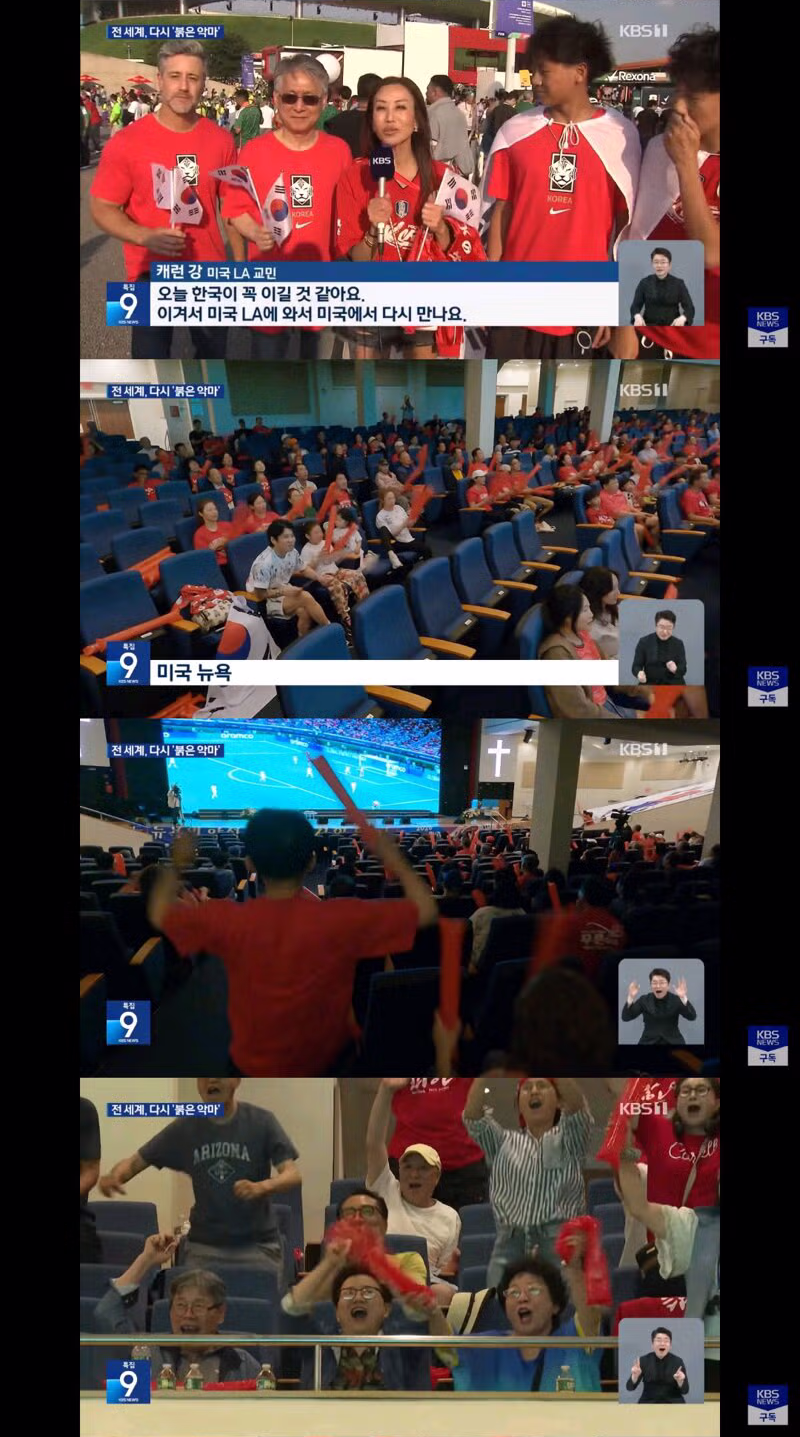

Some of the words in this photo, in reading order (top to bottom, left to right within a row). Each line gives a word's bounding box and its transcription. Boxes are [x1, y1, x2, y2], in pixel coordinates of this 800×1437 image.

[618, 71, 657, 82] Rexona
[372, 157, 391, 165] KBS
[547, 194, 573, 205] KOREA
[291, 210, 314, 218] KOREA
[220, 731, 254, 740] aramco
[192, 1141, 251, 1166] ARIZONA
